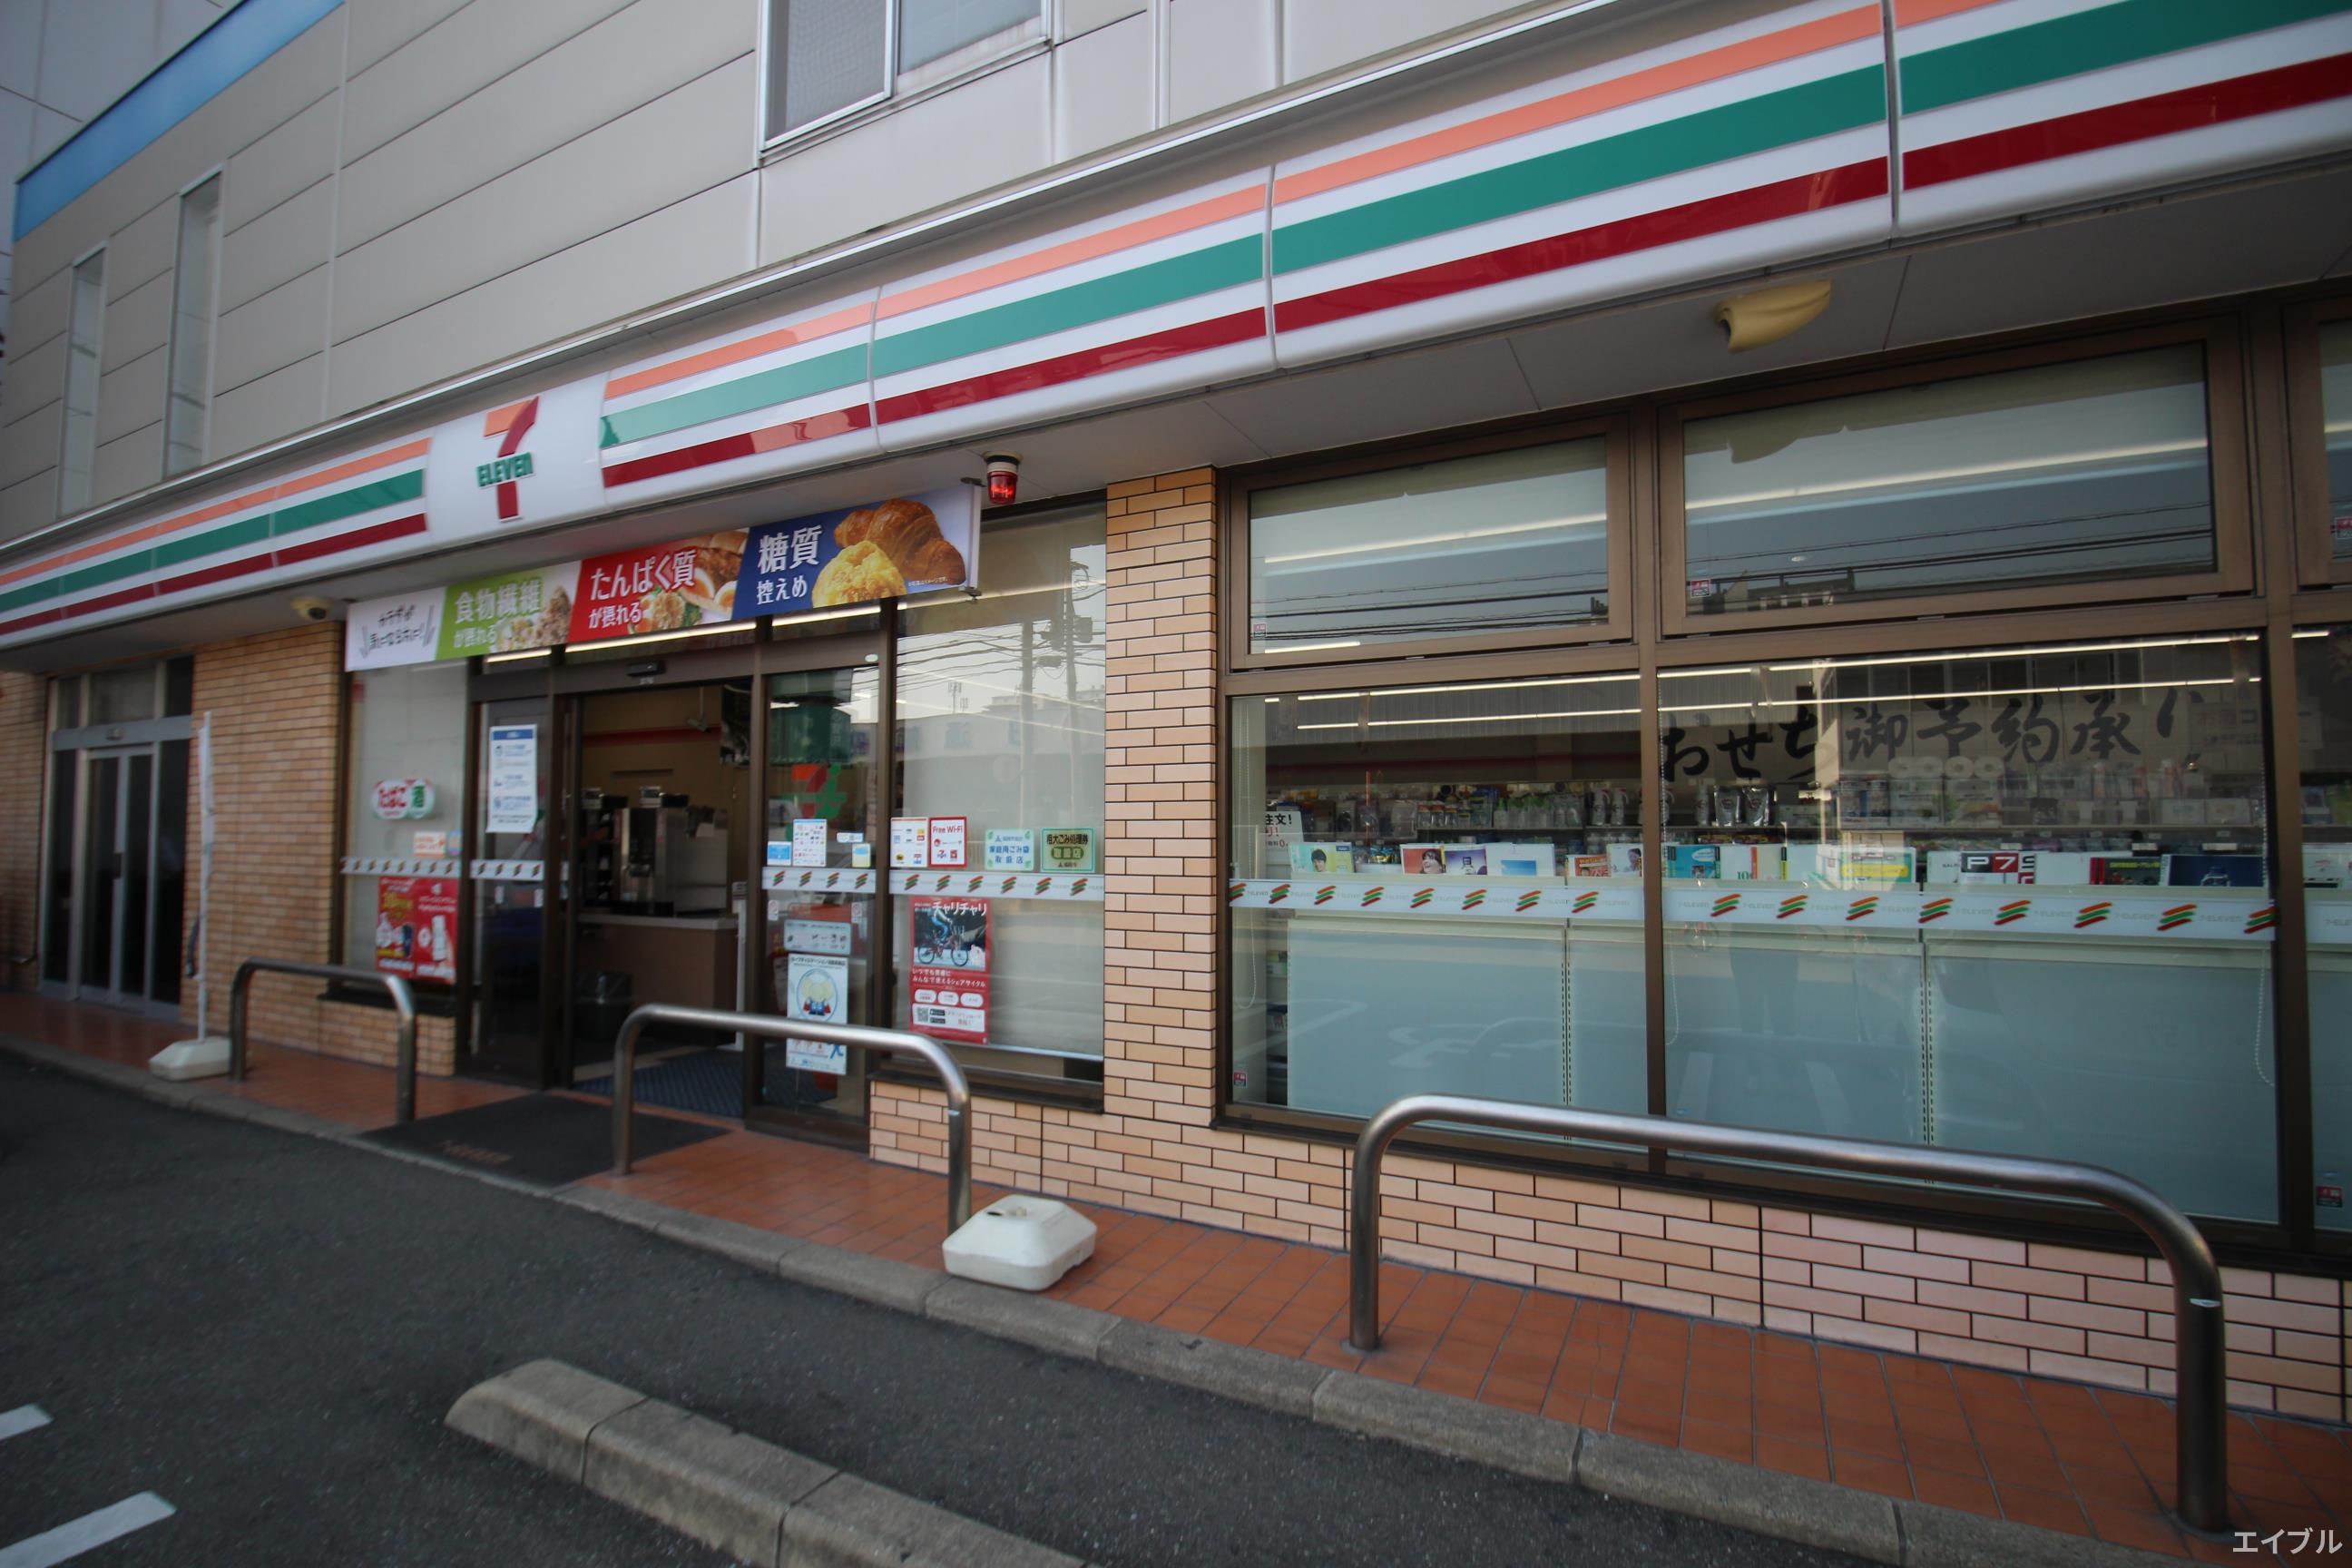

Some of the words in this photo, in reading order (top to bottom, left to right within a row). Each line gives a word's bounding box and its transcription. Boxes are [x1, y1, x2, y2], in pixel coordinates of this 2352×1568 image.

[758, 525, 822, 574] 糖質
[591, 549, 697, 600] たんぱく質
[456, 579, 541, 624] 食物繊維
[757, 575, 808, 605] 控えめ
[589, 602, 642, 630] が摂れる
[933, 826, 946, 834] Free
[947, 825, 963, 834] Wi-Fi
[932, 901, 987, 916] チャリチャリ
